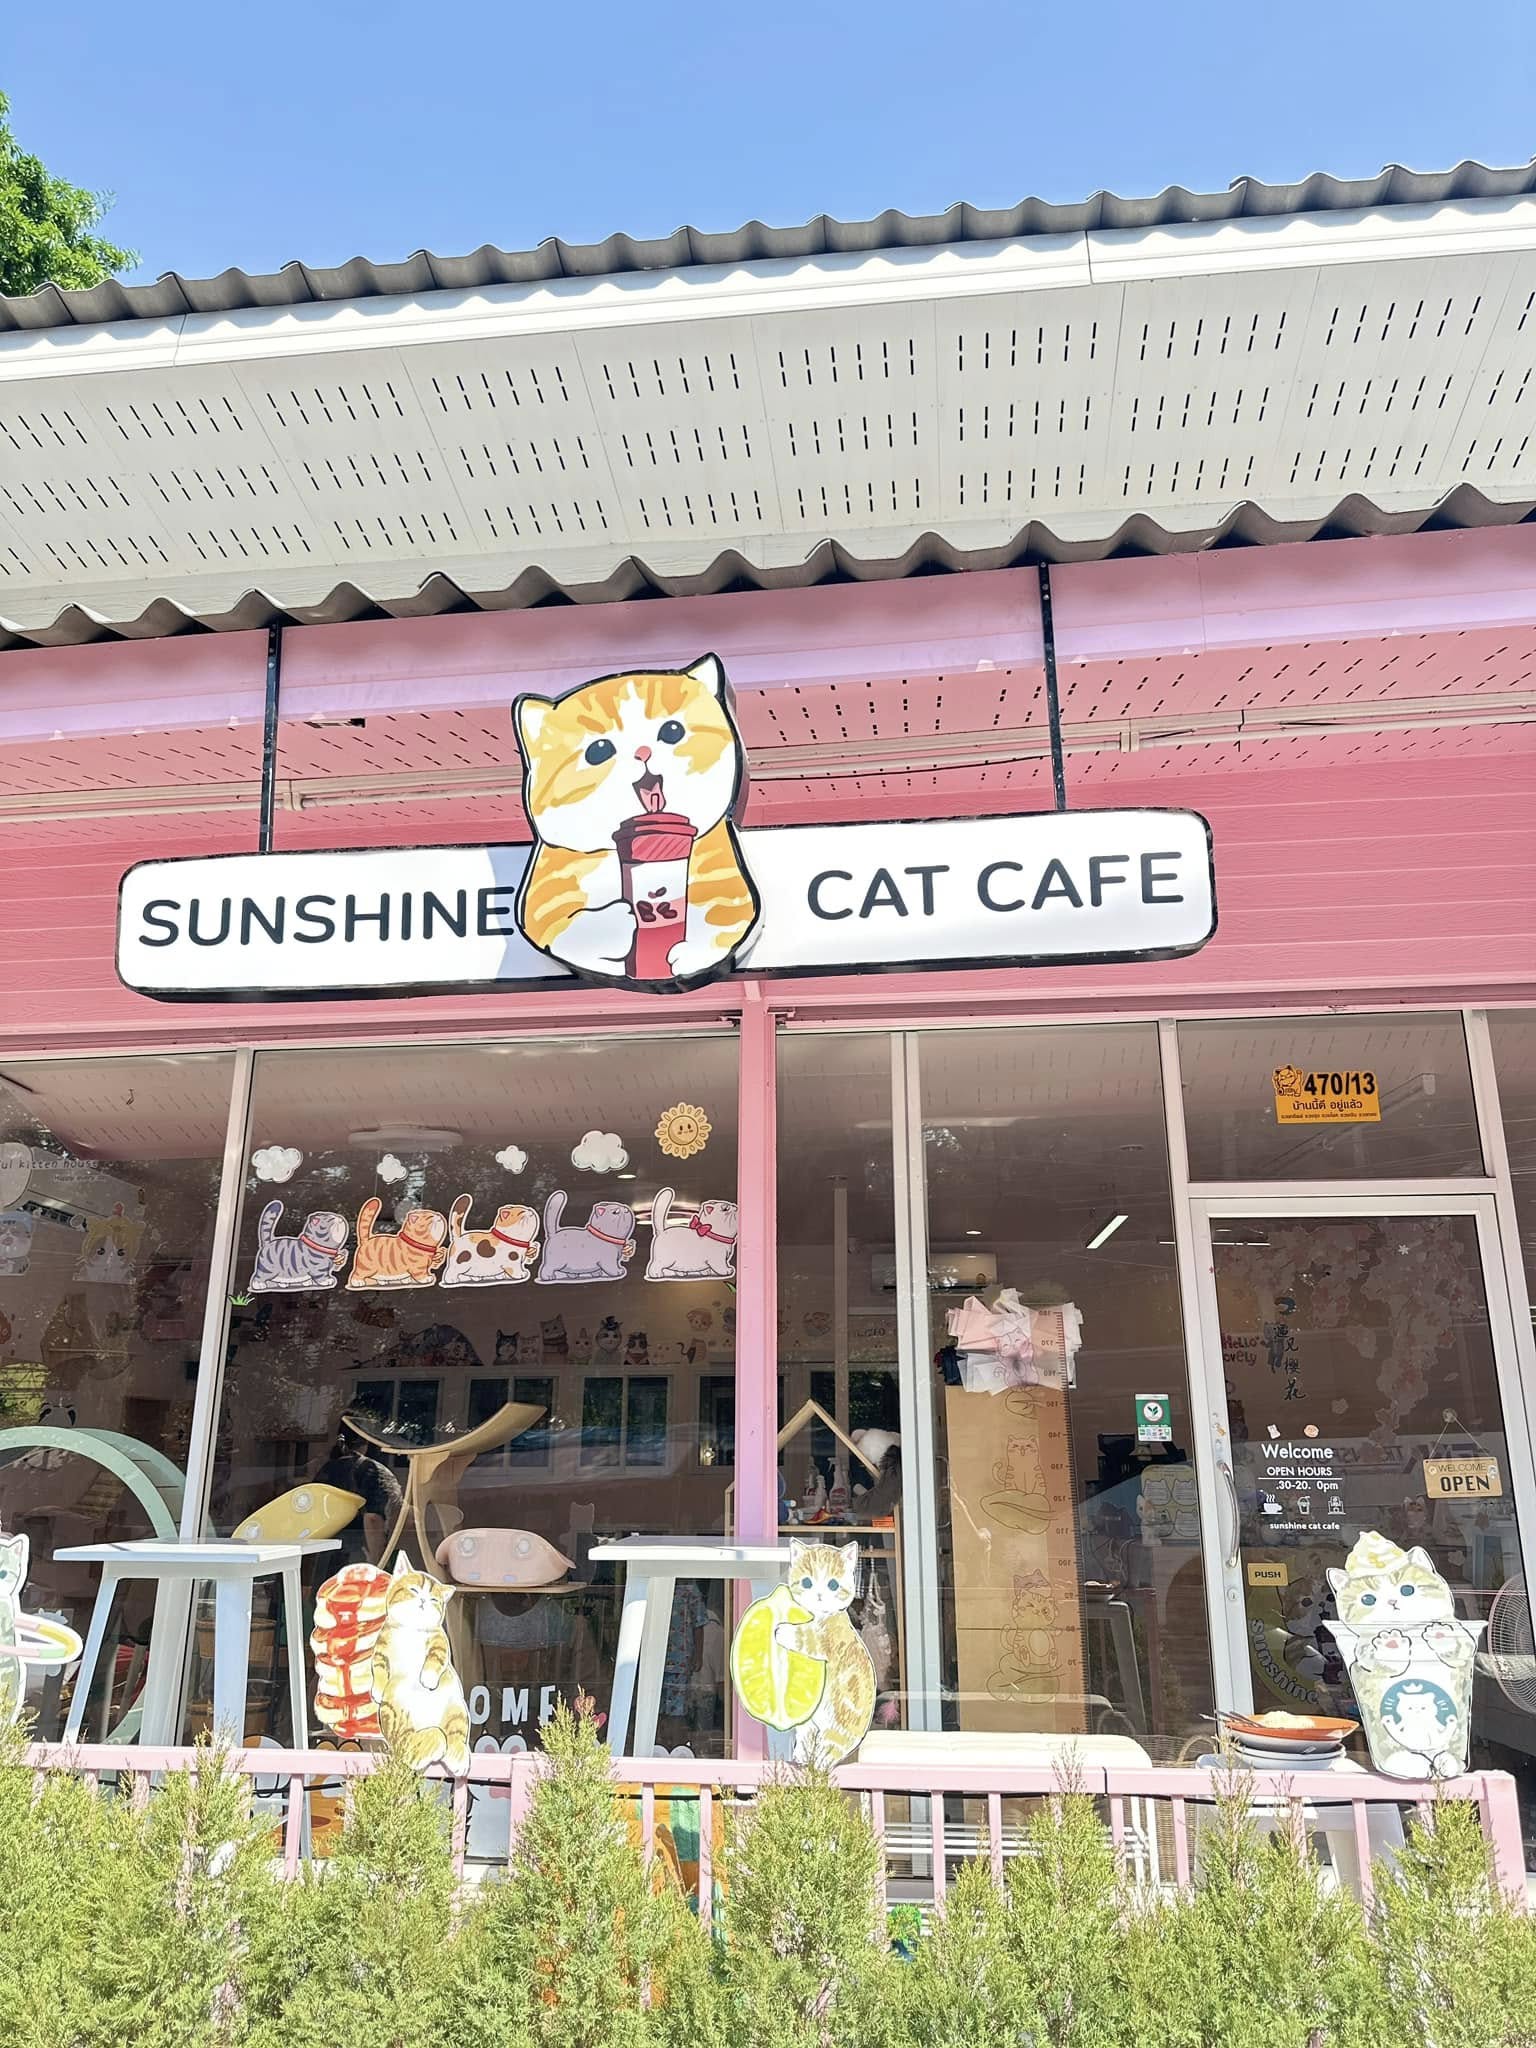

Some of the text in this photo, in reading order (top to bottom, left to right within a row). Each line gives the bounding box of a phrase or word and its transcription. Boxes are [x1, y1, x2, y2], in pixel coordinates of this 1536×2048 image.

[139, 851, 1184, 946] SUNSHINE CAT CAFE
[1303, 1072, 1376, 1096] 470/13
[1261, 1442, 1334, 1459] Welcome
[1266, 1466, 1333, 1476] OPEN HOURS
[1438, 1463, 1487, 1473] WELCOME
[1440, 1475, 1490, 1492] OPEN
[1269, 1521, 1340, 1530] sunshine cat cafe
[1254, 1570, 1281, 1579] PUSH
